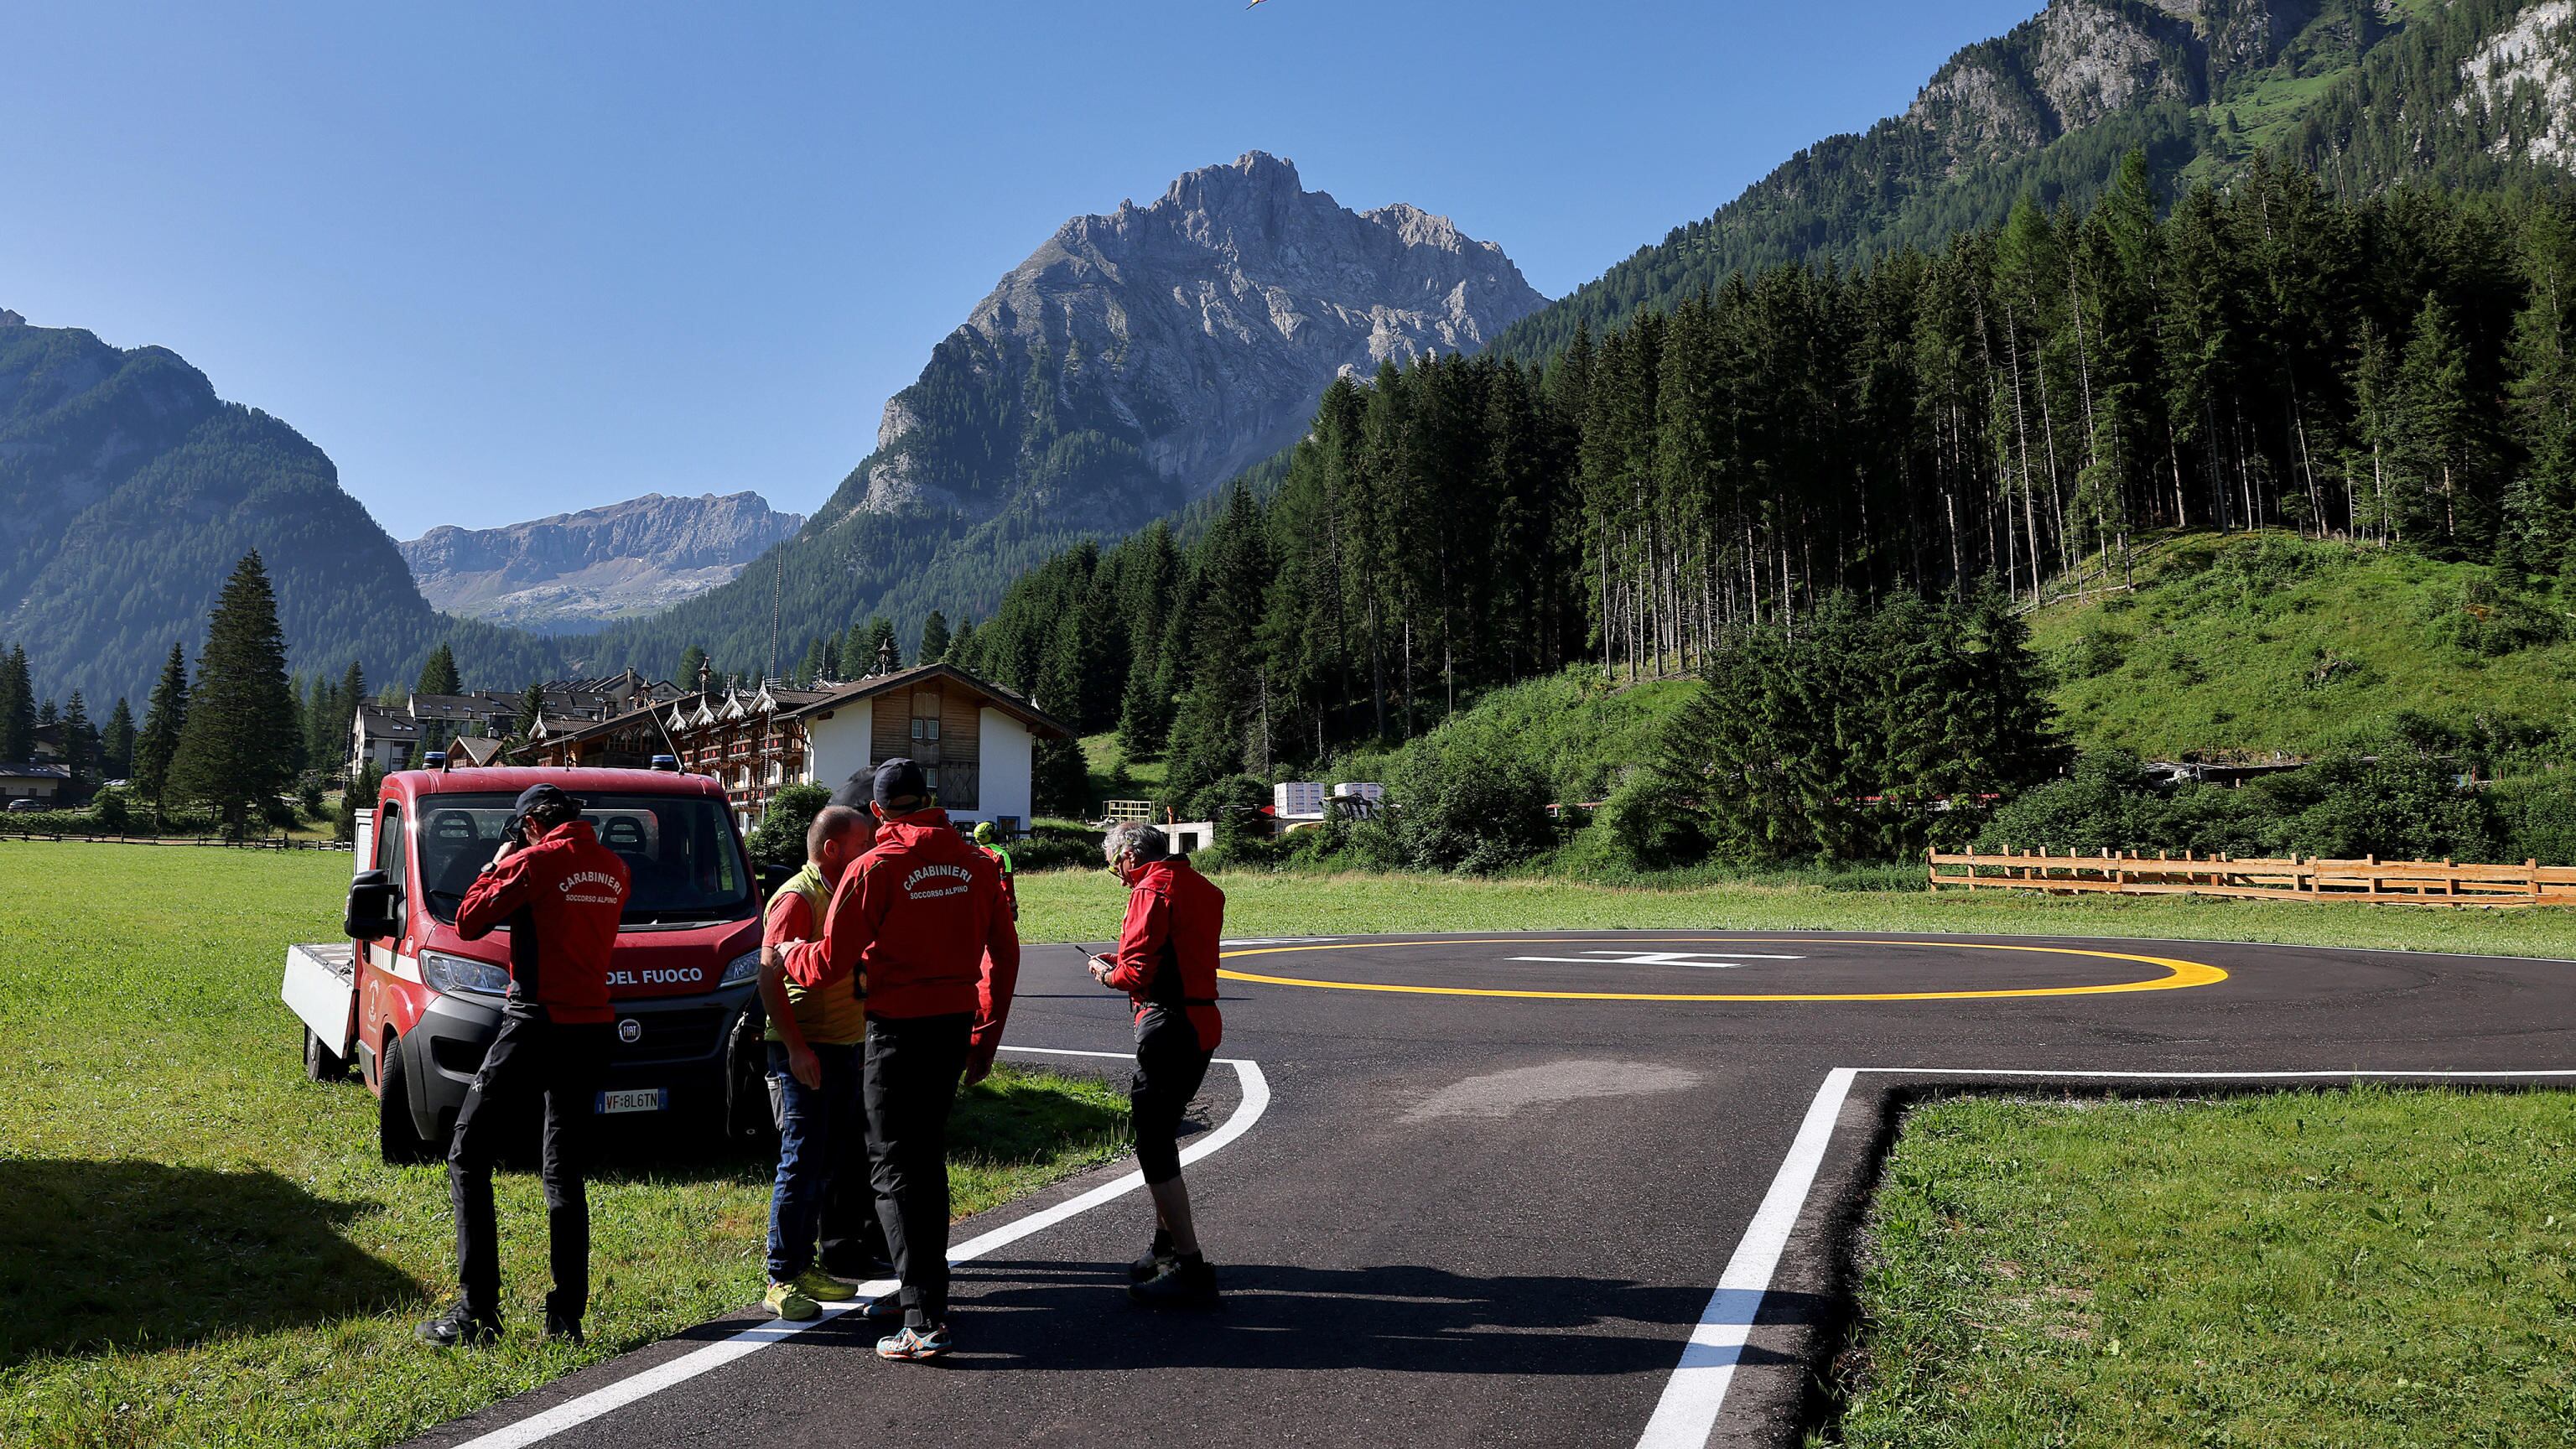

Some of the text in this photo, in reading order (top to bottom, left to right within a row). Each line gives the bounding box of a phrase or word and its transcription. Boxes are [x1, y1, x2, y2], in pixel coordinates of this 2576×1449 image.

[558, 871, 622, 896] CARABINIERI
[903, 865, 973, 891] CARABINIERI
[565, 894, 596, 903] SOCCORSO
[910, 885, 969, 900] SOCCORSO ALPINO
[605, 968, 703, 984] DEL FUOCO
[623, 1026, 637, 1037] FIAT
